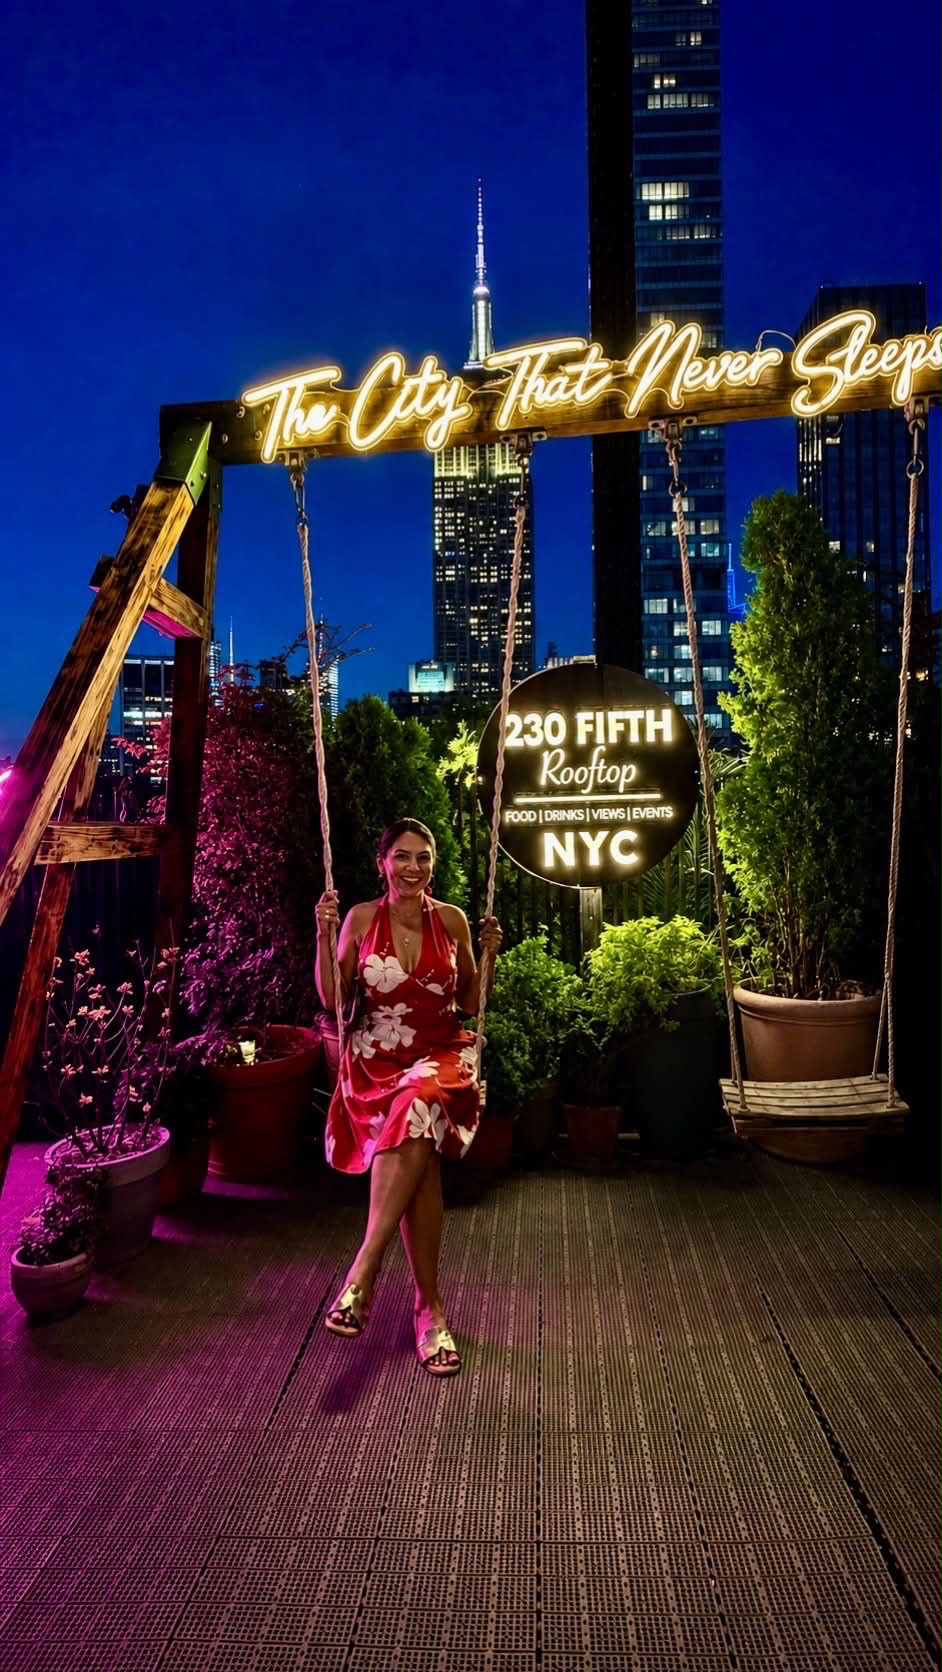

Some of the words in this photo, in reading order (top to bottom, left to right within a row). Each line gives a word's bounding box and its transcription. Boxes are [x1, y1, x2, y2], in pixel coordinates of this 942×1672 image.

[244, 367, 342, 463] The
[350, 352, 472, 451] City
[484, 338, 612, 430] That
[624, 321, 783, 418] Never
[505, 712, 567, 747] 230
[576, 709, 673, 744] FIFTH
[540, 745, 637, 793] Rooftop
[505, 811, 537, 822] FOOD
[544, 809, 585, 821] DRINKS
[592, 808, 626, 820] VIEWS
[632, 806, 673, 818] EVENTS
[543, 830, 639, 867] NYC
